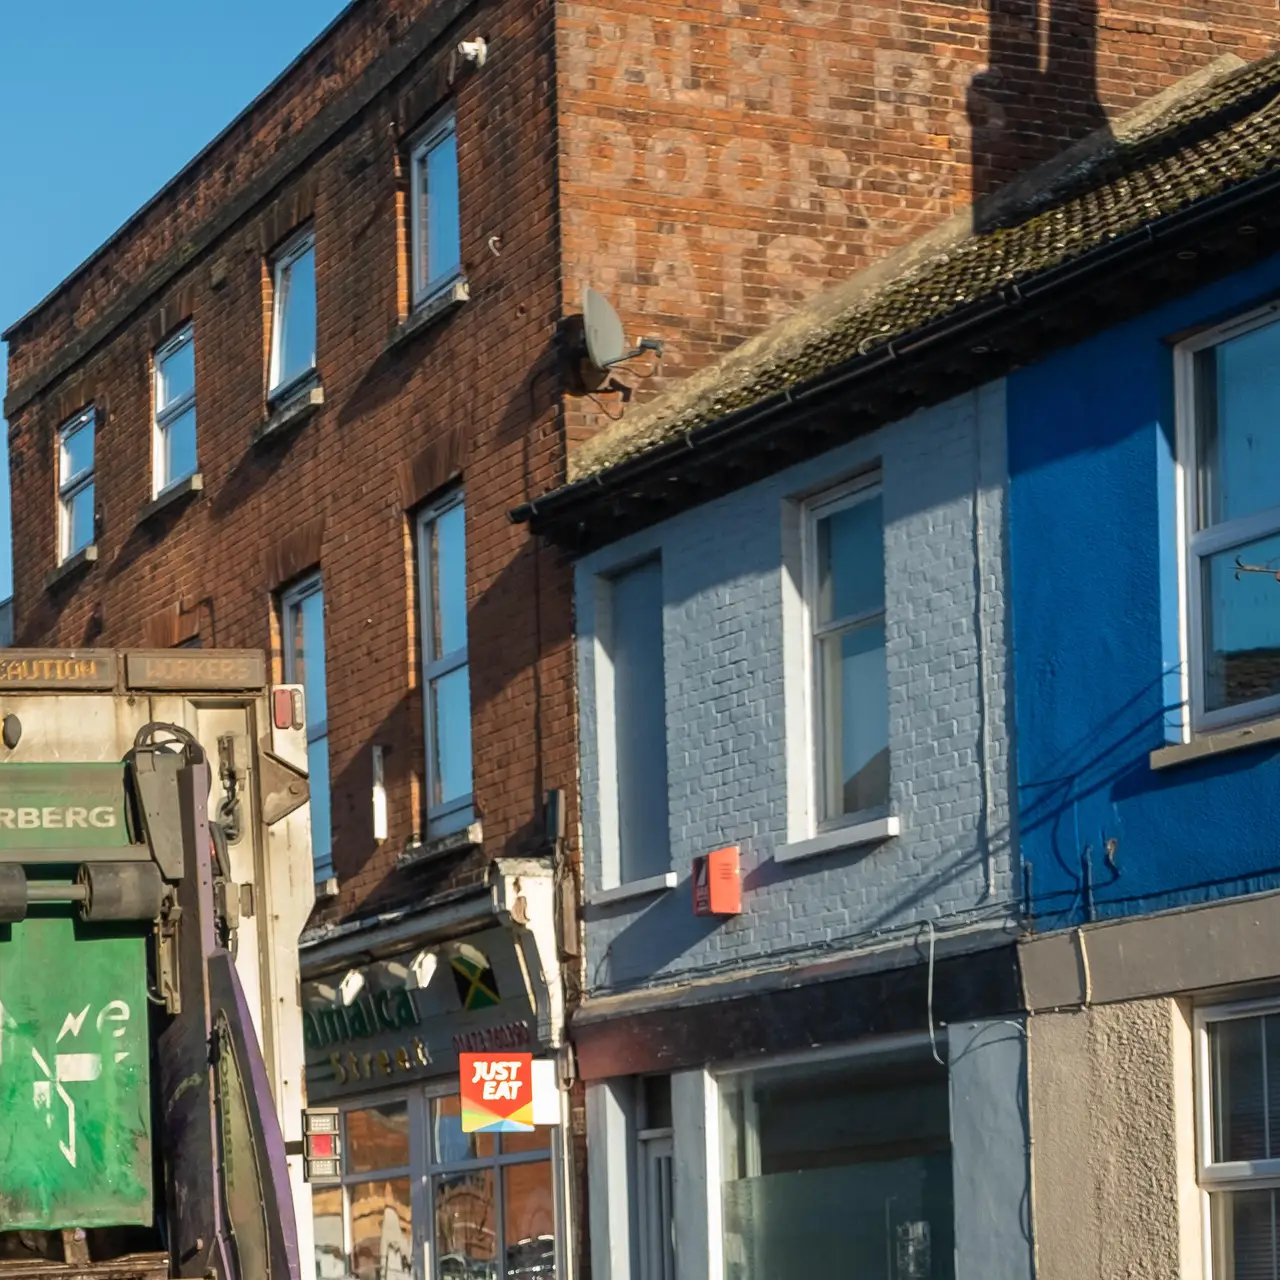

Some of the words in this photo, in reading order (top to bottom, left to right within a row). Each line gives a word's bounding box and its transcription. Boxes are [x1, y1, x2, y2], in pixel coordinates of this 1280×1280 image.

[145, 659, 250, 681] WORKERS
[330, 1037, 432, 1085] Street
[472, 1061, 522, 1084] JUST
[482, 1081, 523, 1101] EAT
